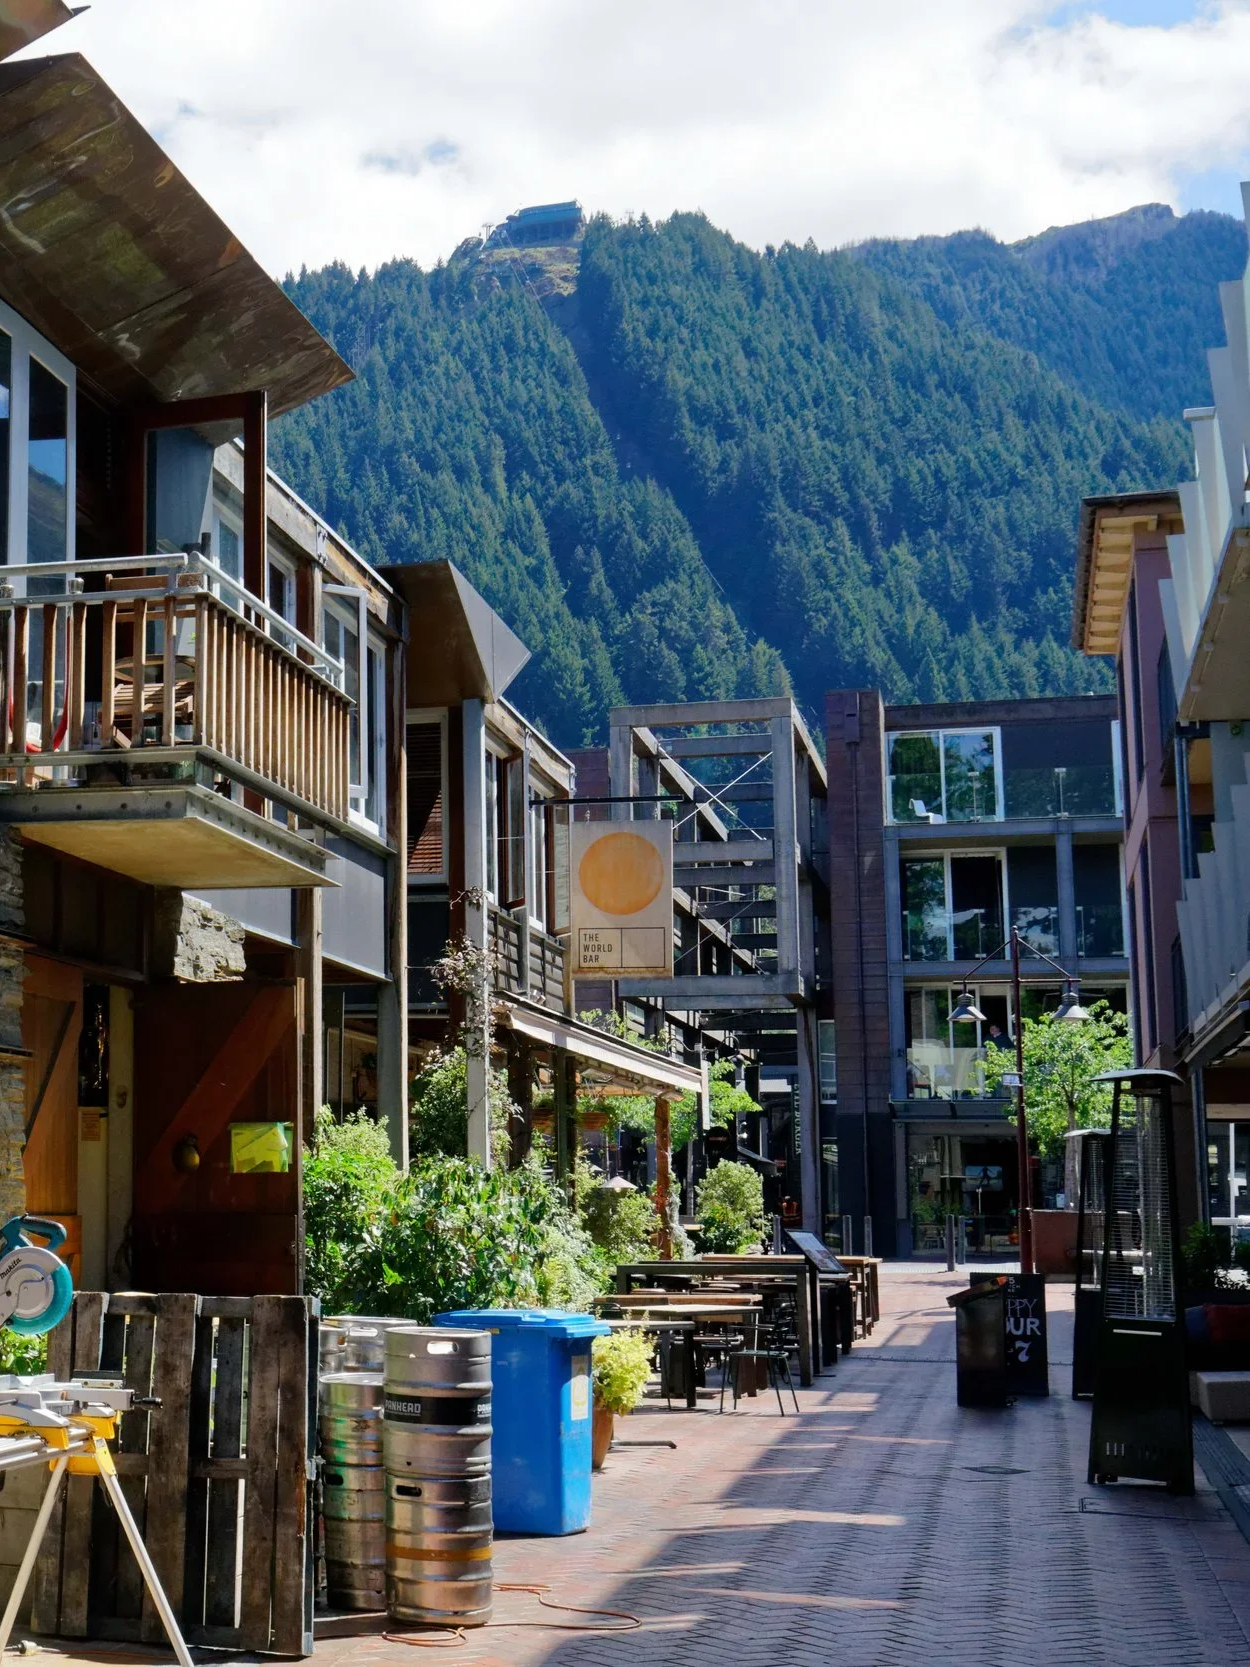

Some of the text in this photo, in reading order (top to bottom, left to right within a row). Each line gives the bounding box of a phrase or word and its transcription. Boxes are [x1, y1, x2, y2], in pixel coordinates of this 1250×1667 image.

[583, 933, 599, 942] THE
[583, 943, 613, 953] WORLD
[583, 954, 600, 964] BAR
[1007, 1298, 1038, 1317] PPY
[385, 1399, 422, 1414] PANHEAD
